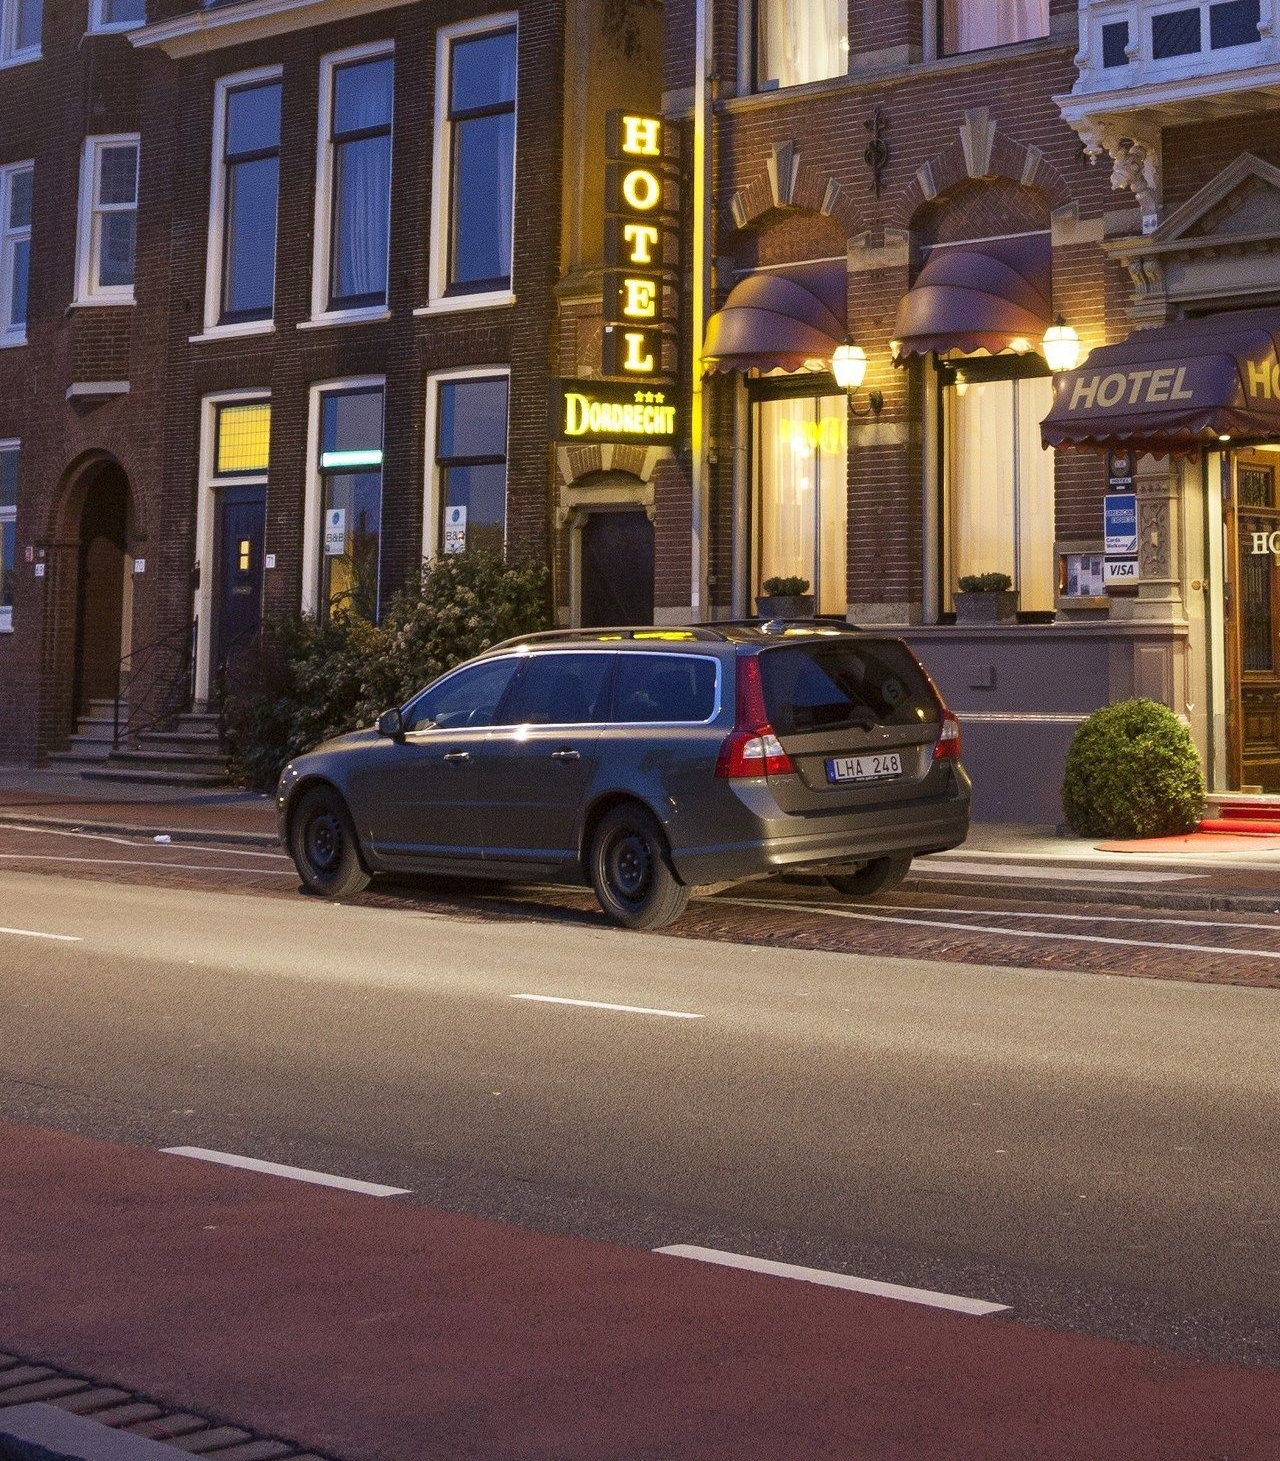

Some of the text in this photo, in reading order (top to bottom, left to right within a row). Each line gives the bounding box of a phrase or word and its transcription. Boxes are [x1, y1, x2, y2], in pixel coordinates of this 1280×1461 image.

[622, 116, 661, 372] HOTEL
[1068, 367, 1193, 410] HOTEL
[326, 533, 344, 543] B&B
[1110, 565, 1134, 576] VISA
[836, 755, 898, 777] LHA 248
